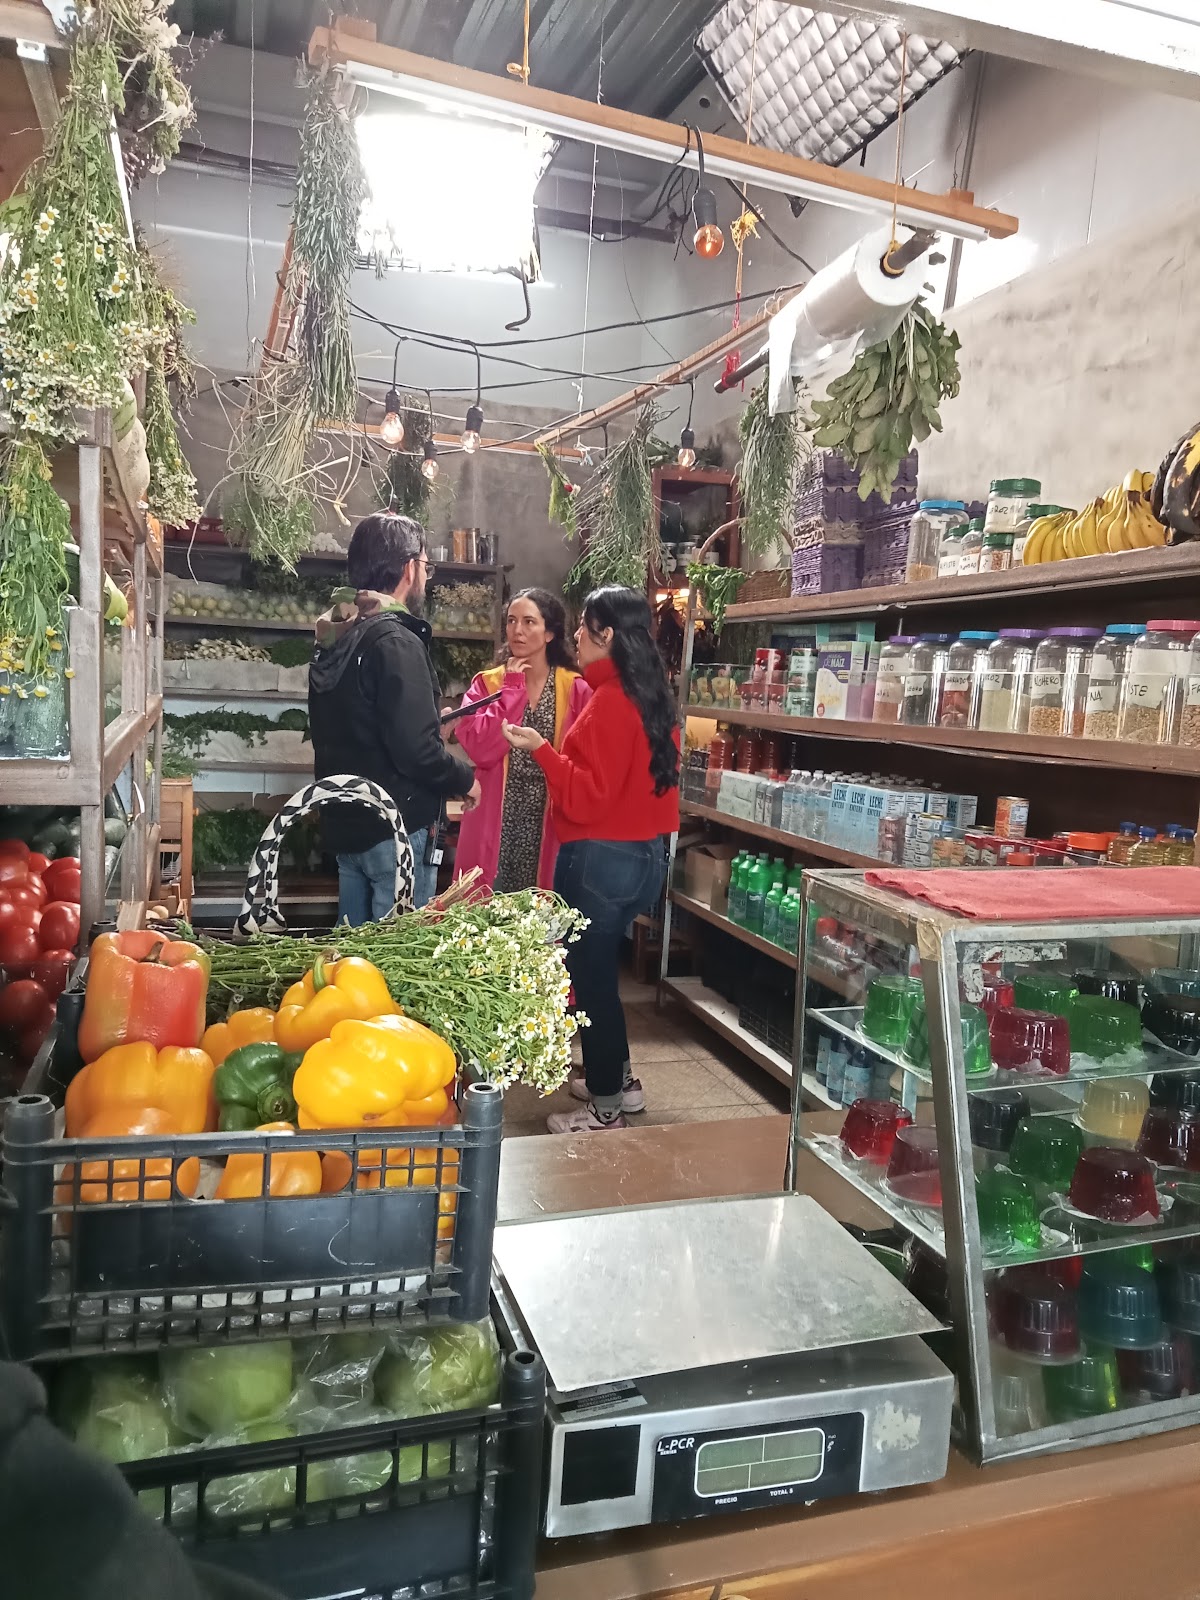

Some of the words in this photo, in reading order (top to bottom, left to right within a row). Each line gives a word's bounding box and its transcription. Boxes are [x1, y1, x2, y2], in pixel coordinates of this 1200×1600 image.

[834, 789, 847, 801] LECHE
[852, 792, 865, 805] LECHE
[870, 796, 883, 809] LECHE
[657, 1437, 695, 1453] L-PCR
[770, 1488, 788, 1496] TOTAL
[715, 1496, 738, 1505] PRECIO
